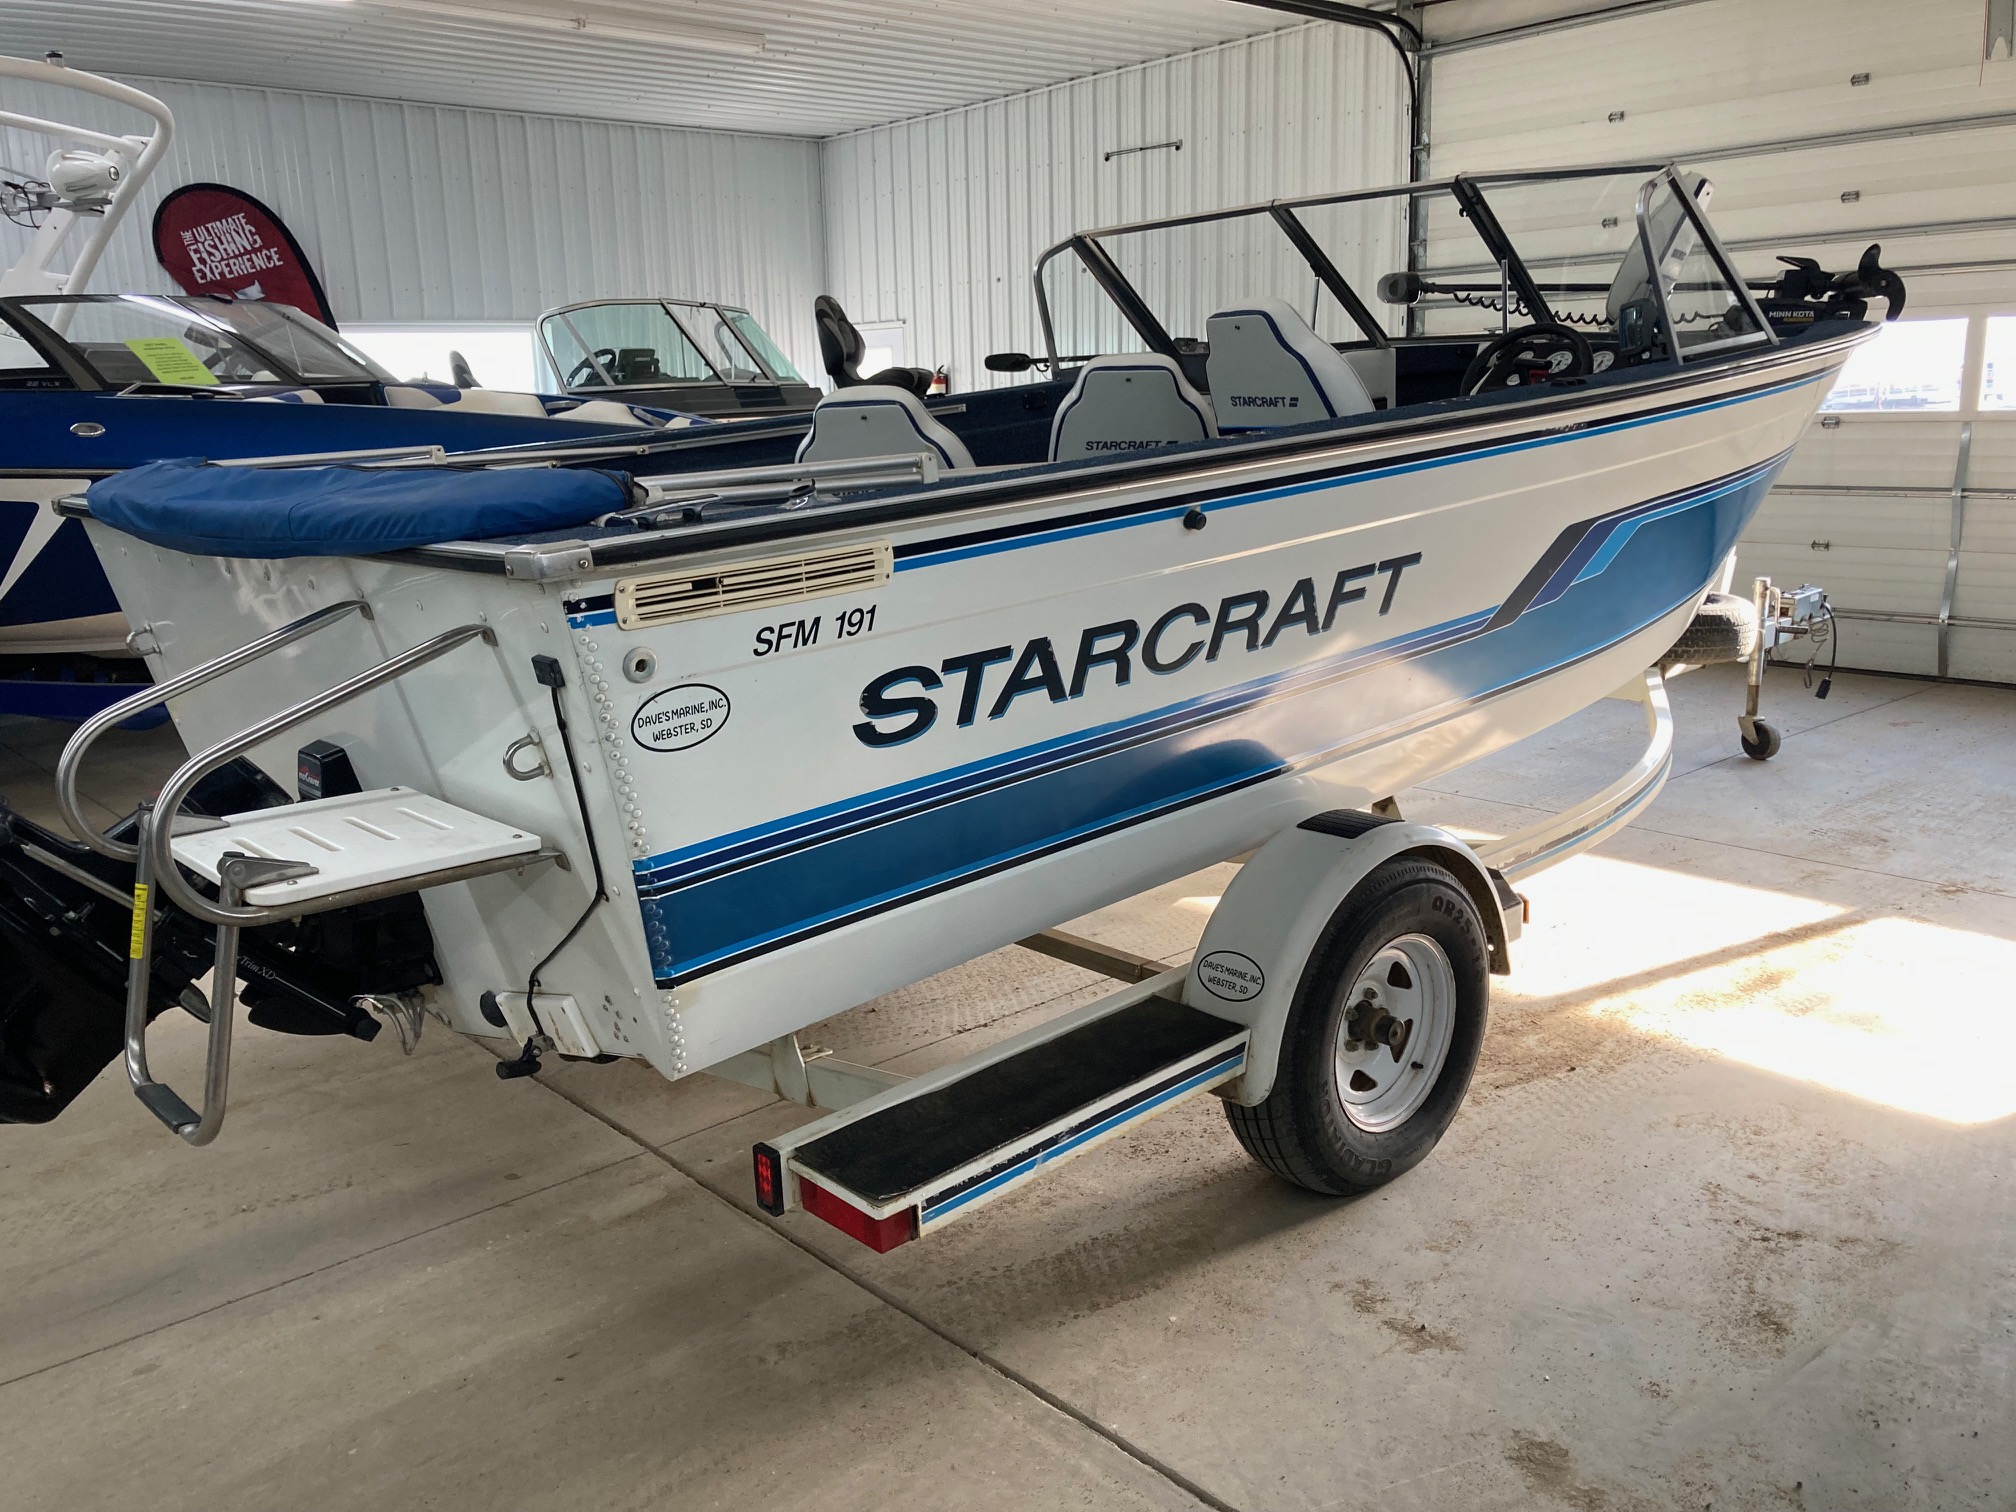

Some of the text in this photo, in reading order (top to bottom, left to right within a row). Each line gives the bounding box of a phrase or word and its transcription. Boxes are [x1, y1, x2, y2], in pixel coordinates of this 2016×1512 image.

[180, 229, 196, 246] THE
[193, 213, 247, 243] ULTIMATE
[187, 224, 263, 269] FISHING
[192, 247, 284, 284] EXPERIENCE
[1230, 396, 1287, 408] STARCRAFT
[752, 604, 877, 657] SFM 191
[852, 551, 1423, 749] STARCRAFT
[637, 711, 671, 729] DAVE'S
[652, 717, 713, 742] WEBSTER, SD
[1207, 974, 1249, 995] WEBSTER, SD
